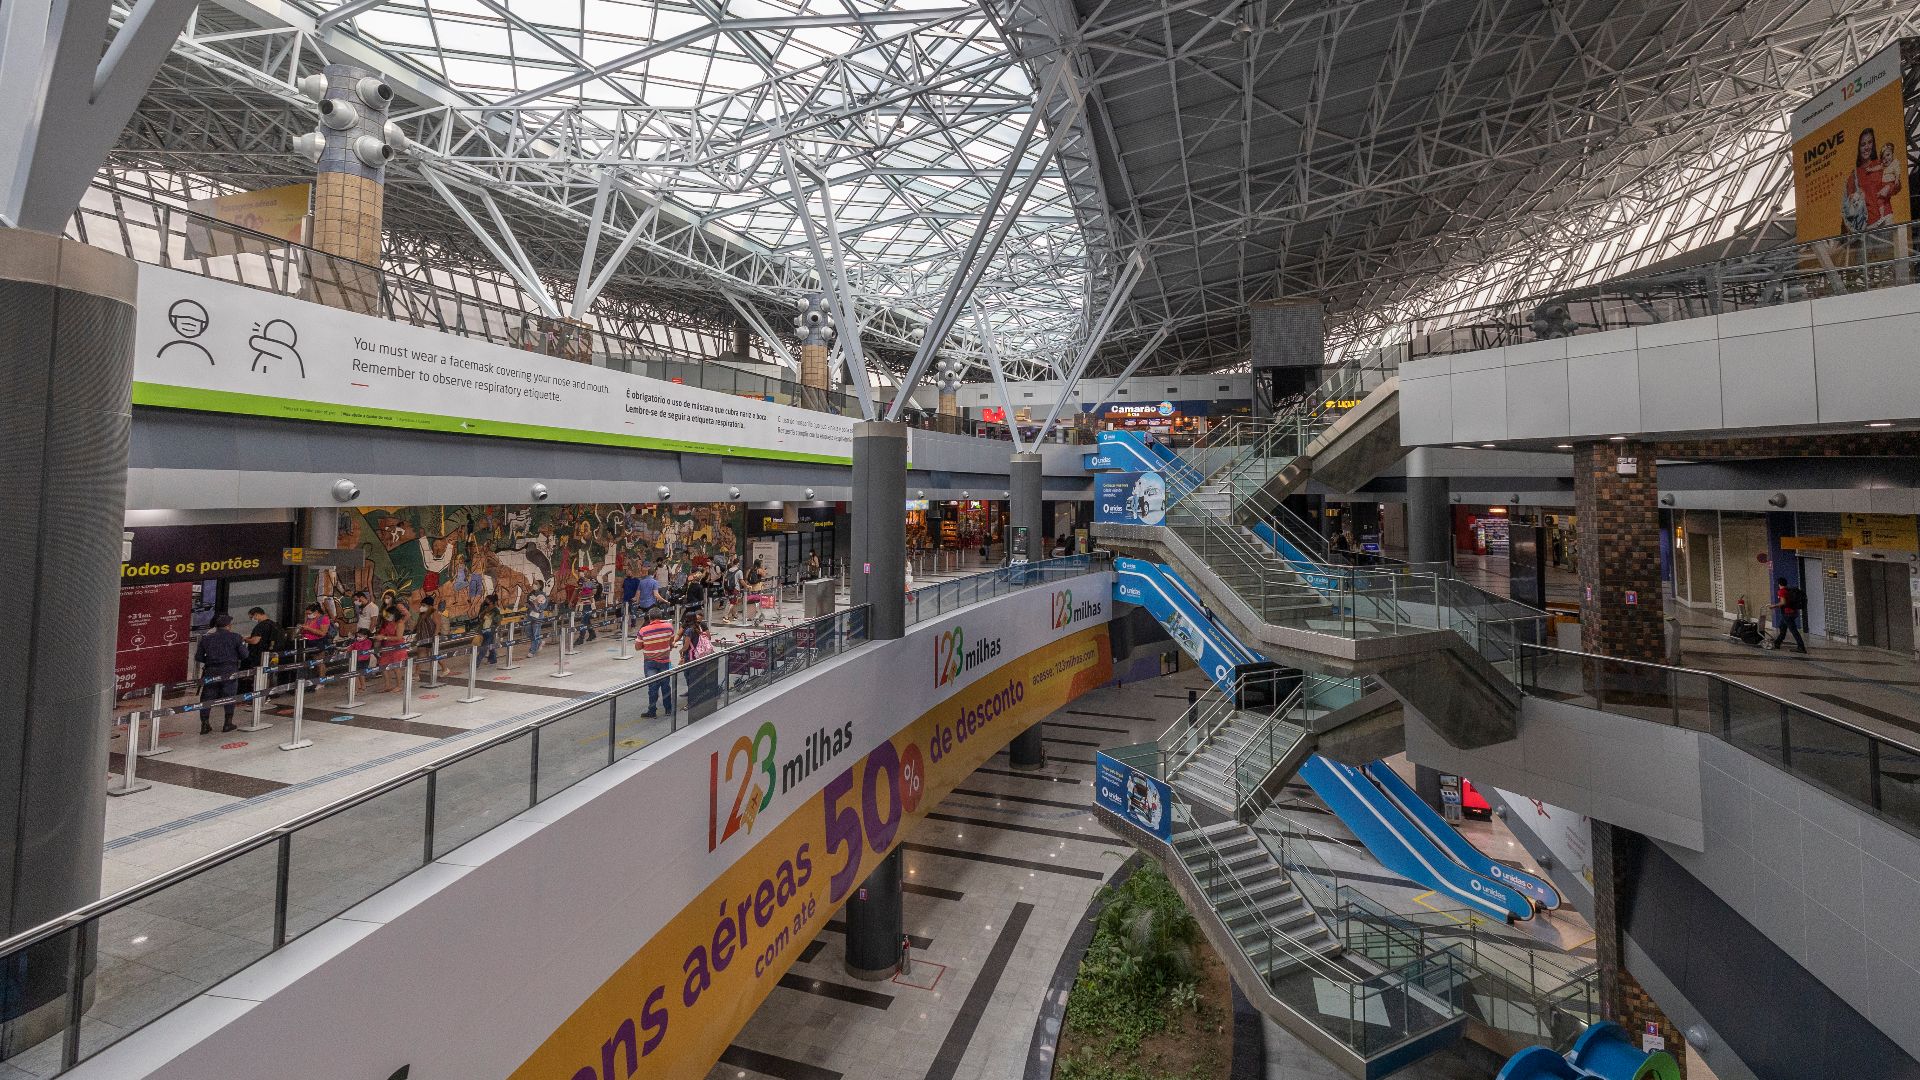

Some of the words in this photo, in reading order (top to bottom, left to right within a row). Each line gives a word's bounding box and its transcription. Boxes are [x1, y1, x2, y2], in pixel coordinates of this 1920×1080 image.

[1840, 77, 1862, 101] 123
[1864, 70, 1886, 90] milhas
[1804, 130, 1844, 164] INOVE
[352, 358, 415, 380] Remember
[419, 370, 430, 382] to
[432, 372, 472, 388] observe
[474, 381, 522, 398] respiratory
[524, 388, 562, 402] etiquette.
[354, 336, 376, 352] You
[380, 344, 408, 358] must
[412, 350, 438, 363] wear
[441, 356, 446, 364] a
[450, 356, 494, 374] facemask
[496, 366, 531, 382] covering
[534, 372, 551, 384] your
[553, 377, 570, 387] nose
[572, 380, 586, 390] and
[626, 388, 630, 398] É
[632, 391, 666, 404] obrigatório
[672, 399, 682, 407] uso
[684, 400, 691, 408] de
[692, 402, 714, 412] máscara
[714, 406, 724, 414] que
[725, 408, 738, 416] cubra
[626, 404, 658, 416] Lembre-se
[660, 409, 667, 418] de
[668, 412, 686, 422] seguir
[692, 414, 714, 425] etiqueta
[120, 562, 170, 578] Todos
[176, 562, 195, 574] os
[201, 556, 260, 574] portões
[1052, 588, 1072, 630] 123
[1074, 600, 1102, 622] milhas
[934, 626, 964, 690] 123
[966, 638, 1000, 672] milhas
[1032, 665, 1055, 686] acesse:
[708, 721, 777, 854] 123
[782, 720, 853, 795] milhas
[683, 842, 812, 1008] aéreas
[930, 724, 952, 764] de
[956, 678, 1024, 744] desconto
[1482, 886, 1506, 901] unidas
[1502, 872, 1526, 887] unidas
[754, 926, 790, 978] com
[793, 892, 816, 936] até
